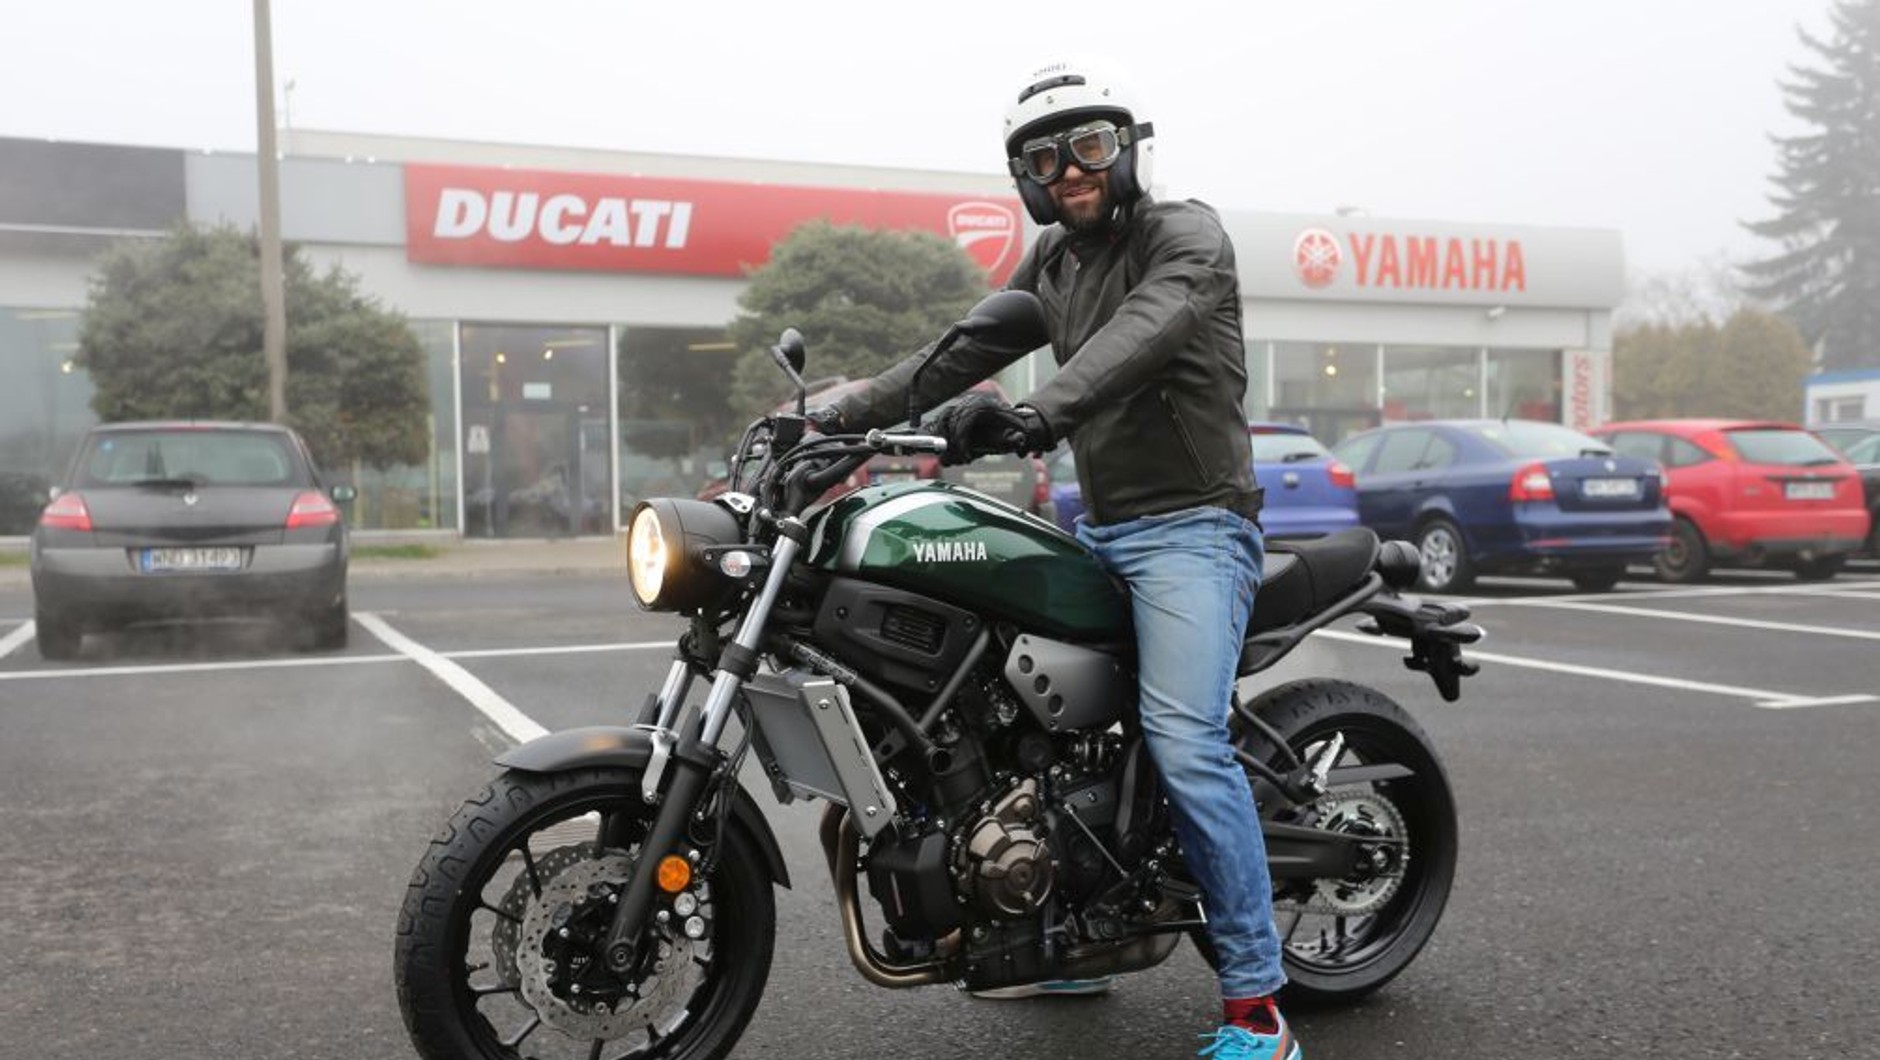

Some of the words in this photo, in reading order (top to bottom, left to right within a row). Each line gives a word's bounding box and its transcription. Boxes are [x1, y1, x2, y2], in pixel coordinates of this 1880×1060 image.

[434, 187, 692, 249] DUCATI
[956, 214, 1007, 228] DUCATI
[1348, 233, 1526, 292] YAMAHA
[913, 542, 987, 562] YAMAHA
